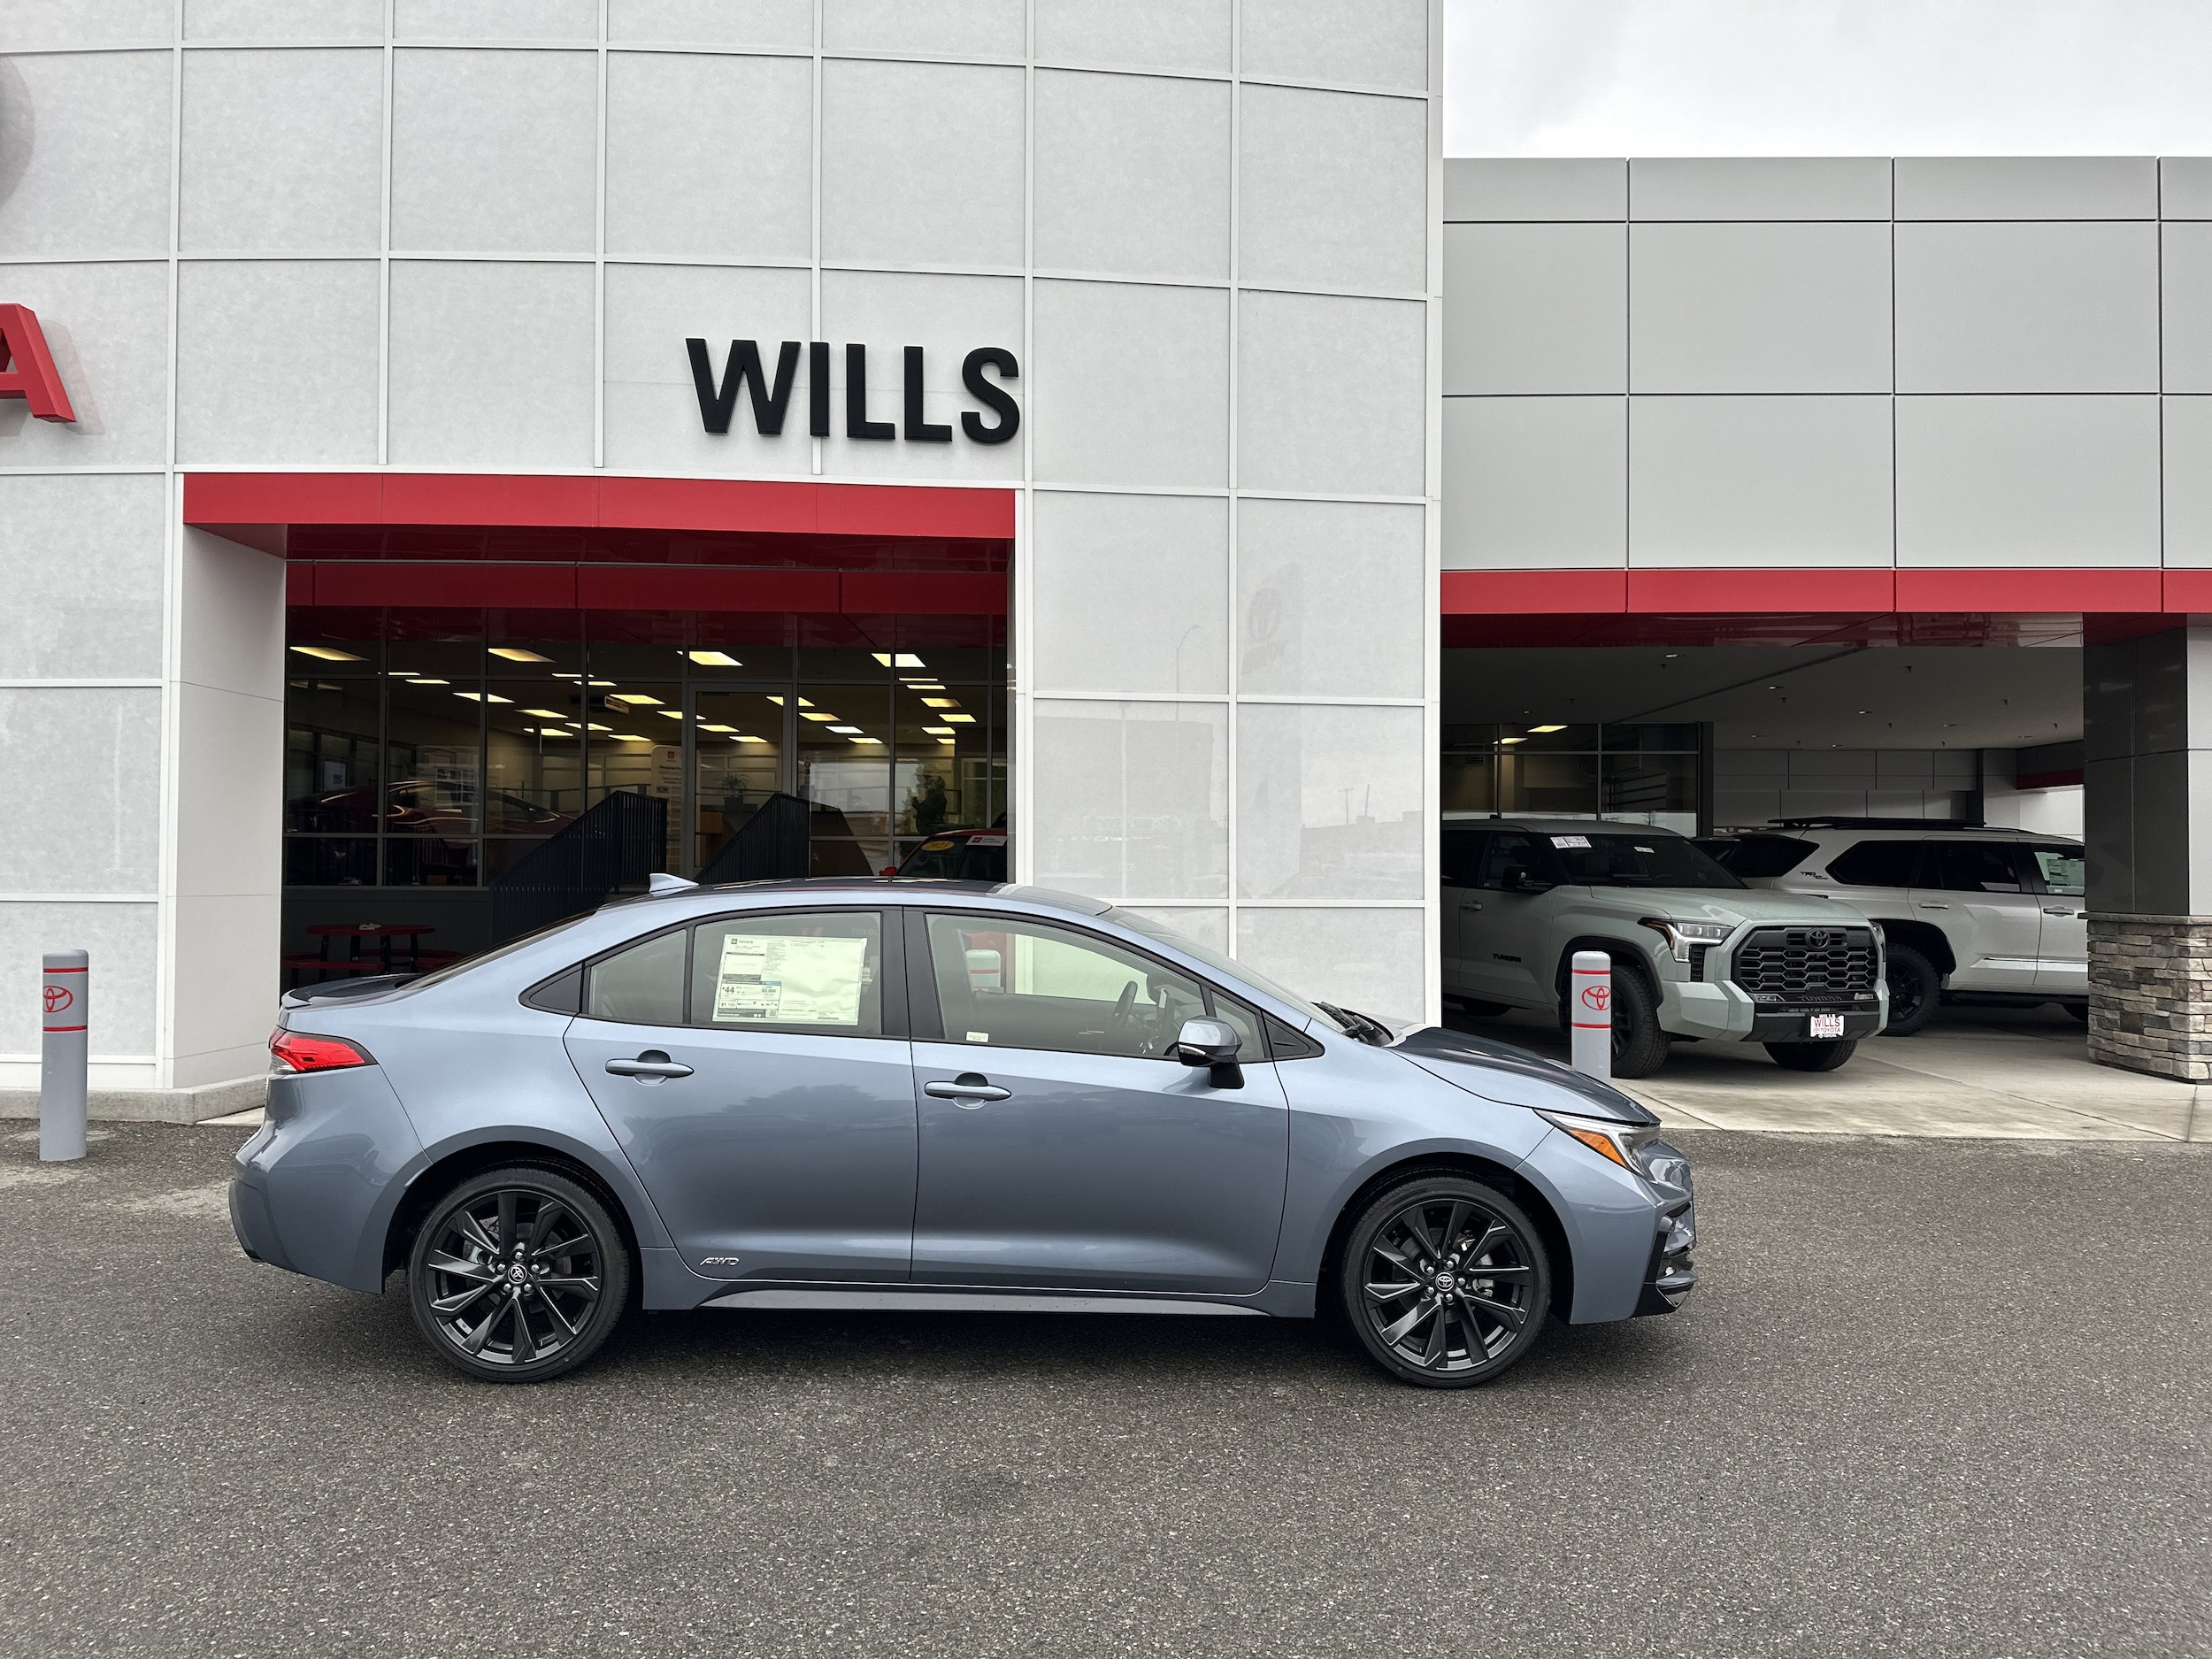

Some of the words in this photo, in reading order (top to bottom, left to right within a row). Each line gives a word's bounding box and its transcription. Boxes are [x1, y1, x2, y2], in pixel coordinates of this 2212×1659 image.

[685, 337, 1020, 444] WILLS
[1814, 1018, 1840, 1027] WILLS
[699, 1256, 740, 1266] AWD
